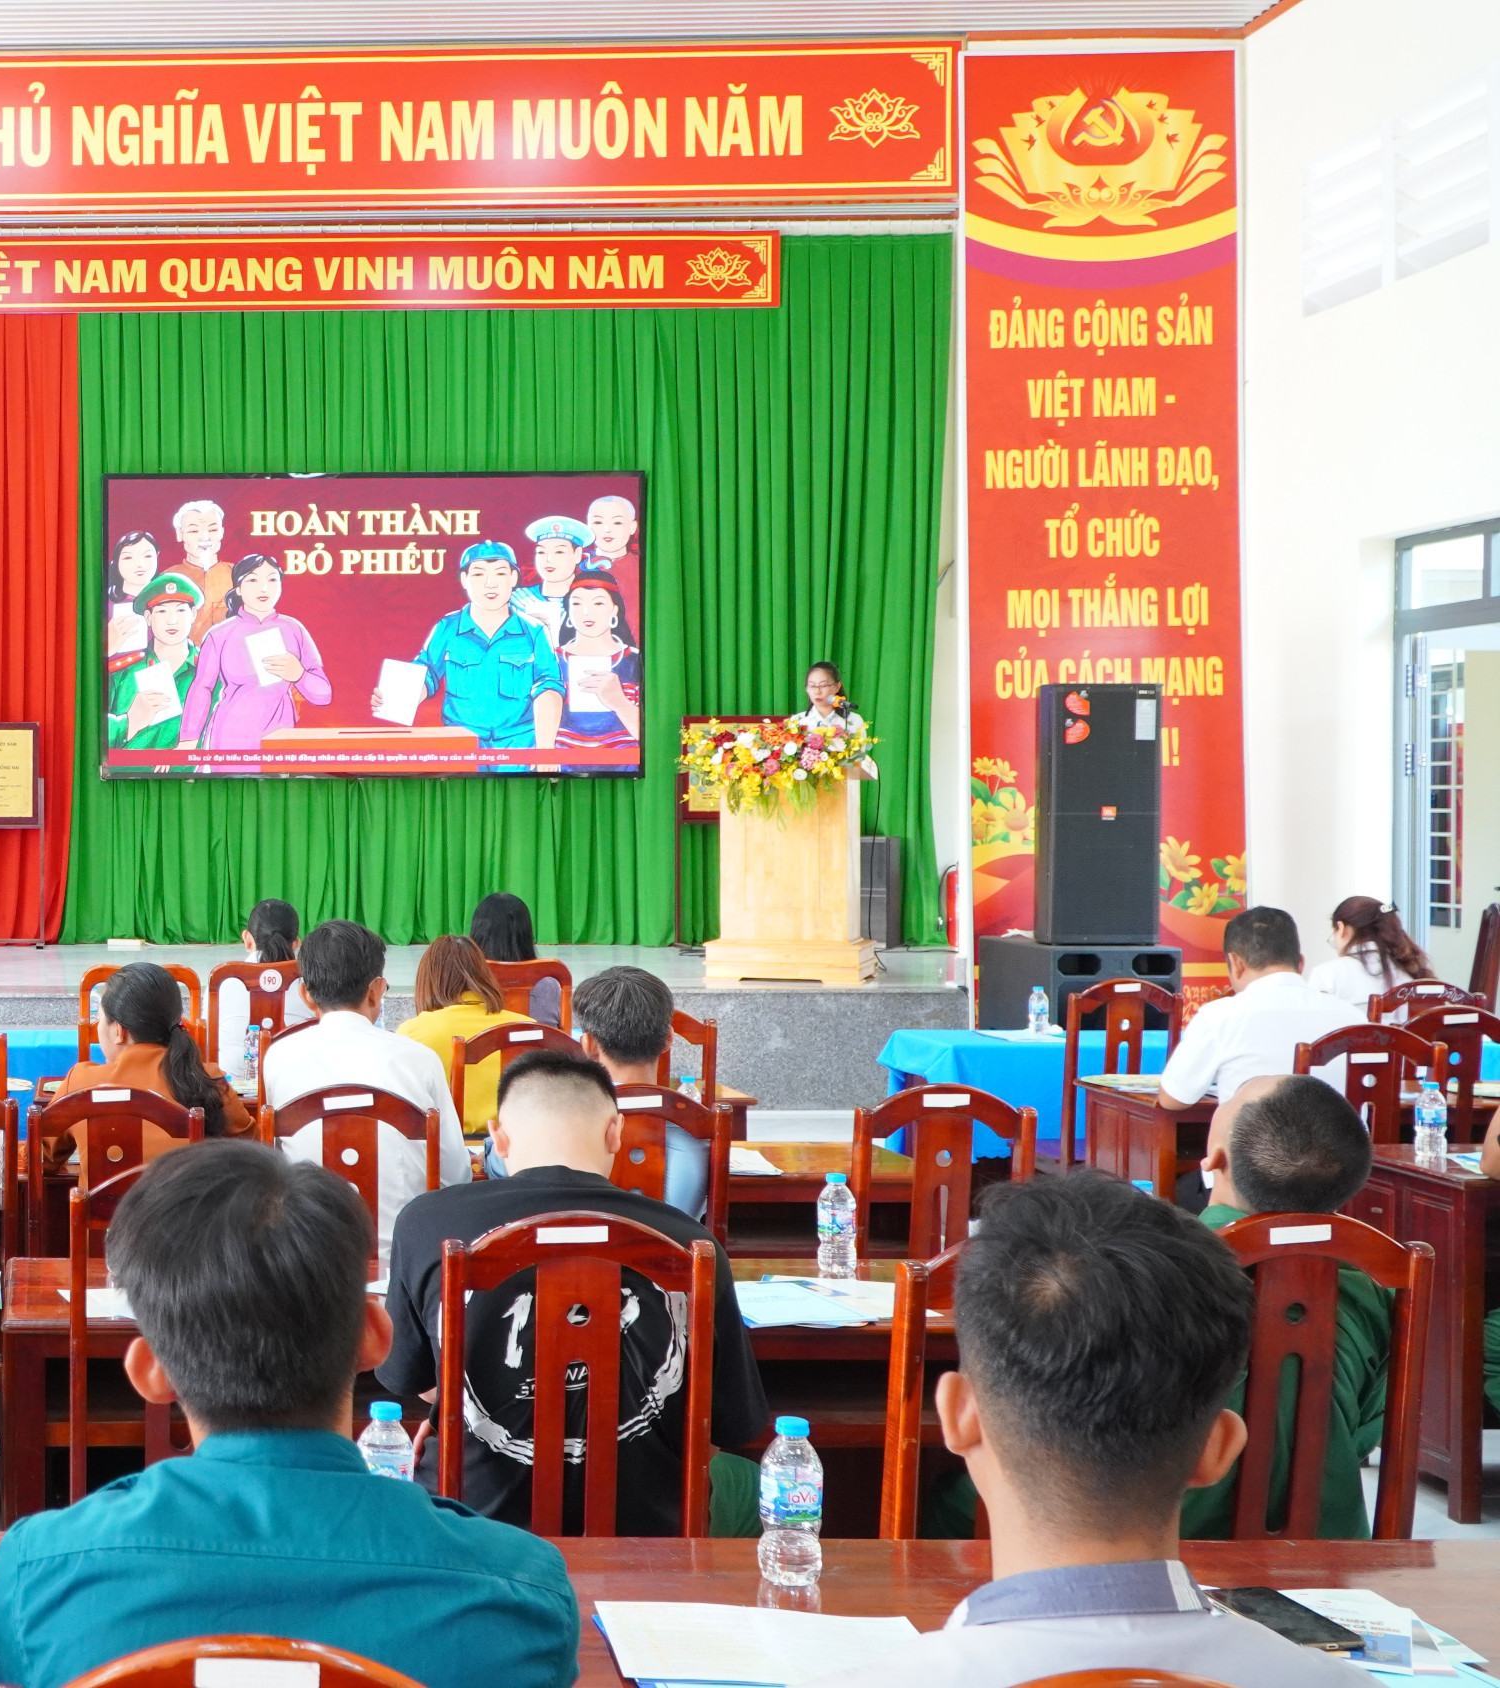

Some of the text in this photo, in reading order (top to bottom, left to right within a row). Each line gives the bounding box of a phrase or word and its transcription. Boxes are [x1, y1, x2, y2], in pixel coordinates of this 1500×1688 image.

[71, 88, 230, 167] NGHĨA
[243, 85, 363, 176] VIỆT
[380, 99, 497, 162] NAM
[510, 81, 668, 166] MUÔN
[684, 82, 804, 158] NĂM
[54, 257, 149, 294] NAM
[166, 256, 304, 298] QUANG
[313, 256, 415, 291] VINH
[426, 247, 556, 290] MUÔN
[566, 248, 665, 289] NĂM
[988, 292, 1213, 356] ĐẢNG CỘNG SẢN
[1026, 370, 1085, 427] VIỆT
[1092, 376, 1157, 418] NAM
[985, 439, 1220, 495] NGƯỜI LÃNH ĐẠO,
[250, 502, 481, 537] HOÀN THÀNH
[1044, 502, 1161, 559] TỔ CHỨC
[283, 542, 447, 576] BỎ PHIẾU
[1007, 572, 1209, 638] MỌI THẮNG LỢI
[995, 646, 1049, 700] CỦA
[1139, 655, 1224, 706] MẠNG
[263, 976, 277, 985] 190
